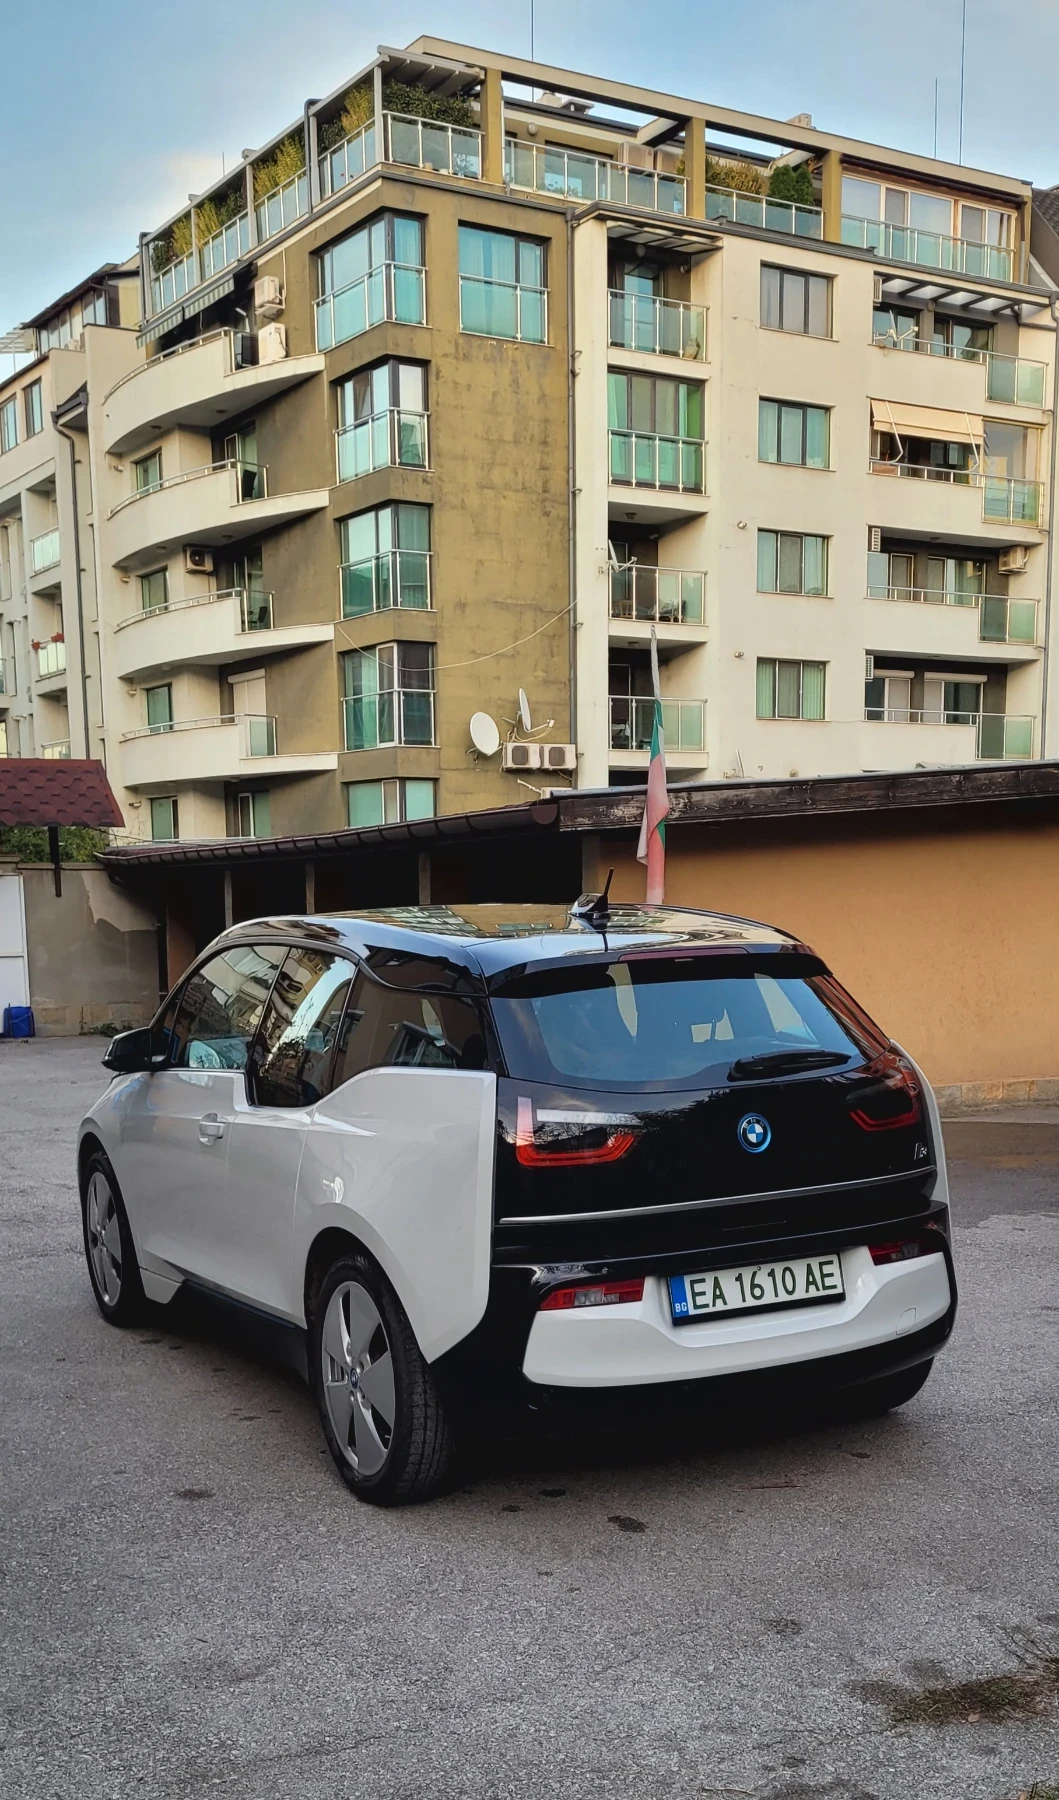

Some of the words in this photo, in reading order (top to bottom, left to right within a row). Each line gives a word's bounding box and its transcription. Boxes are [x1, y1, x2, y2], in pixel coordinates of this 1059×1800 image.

[689, 1277, 728, 1310] EA
[735, 1266, 796, 1303] 1610
[805, 1260, 838, 1293] AE
[675, 1302, 687, 1313] BG
